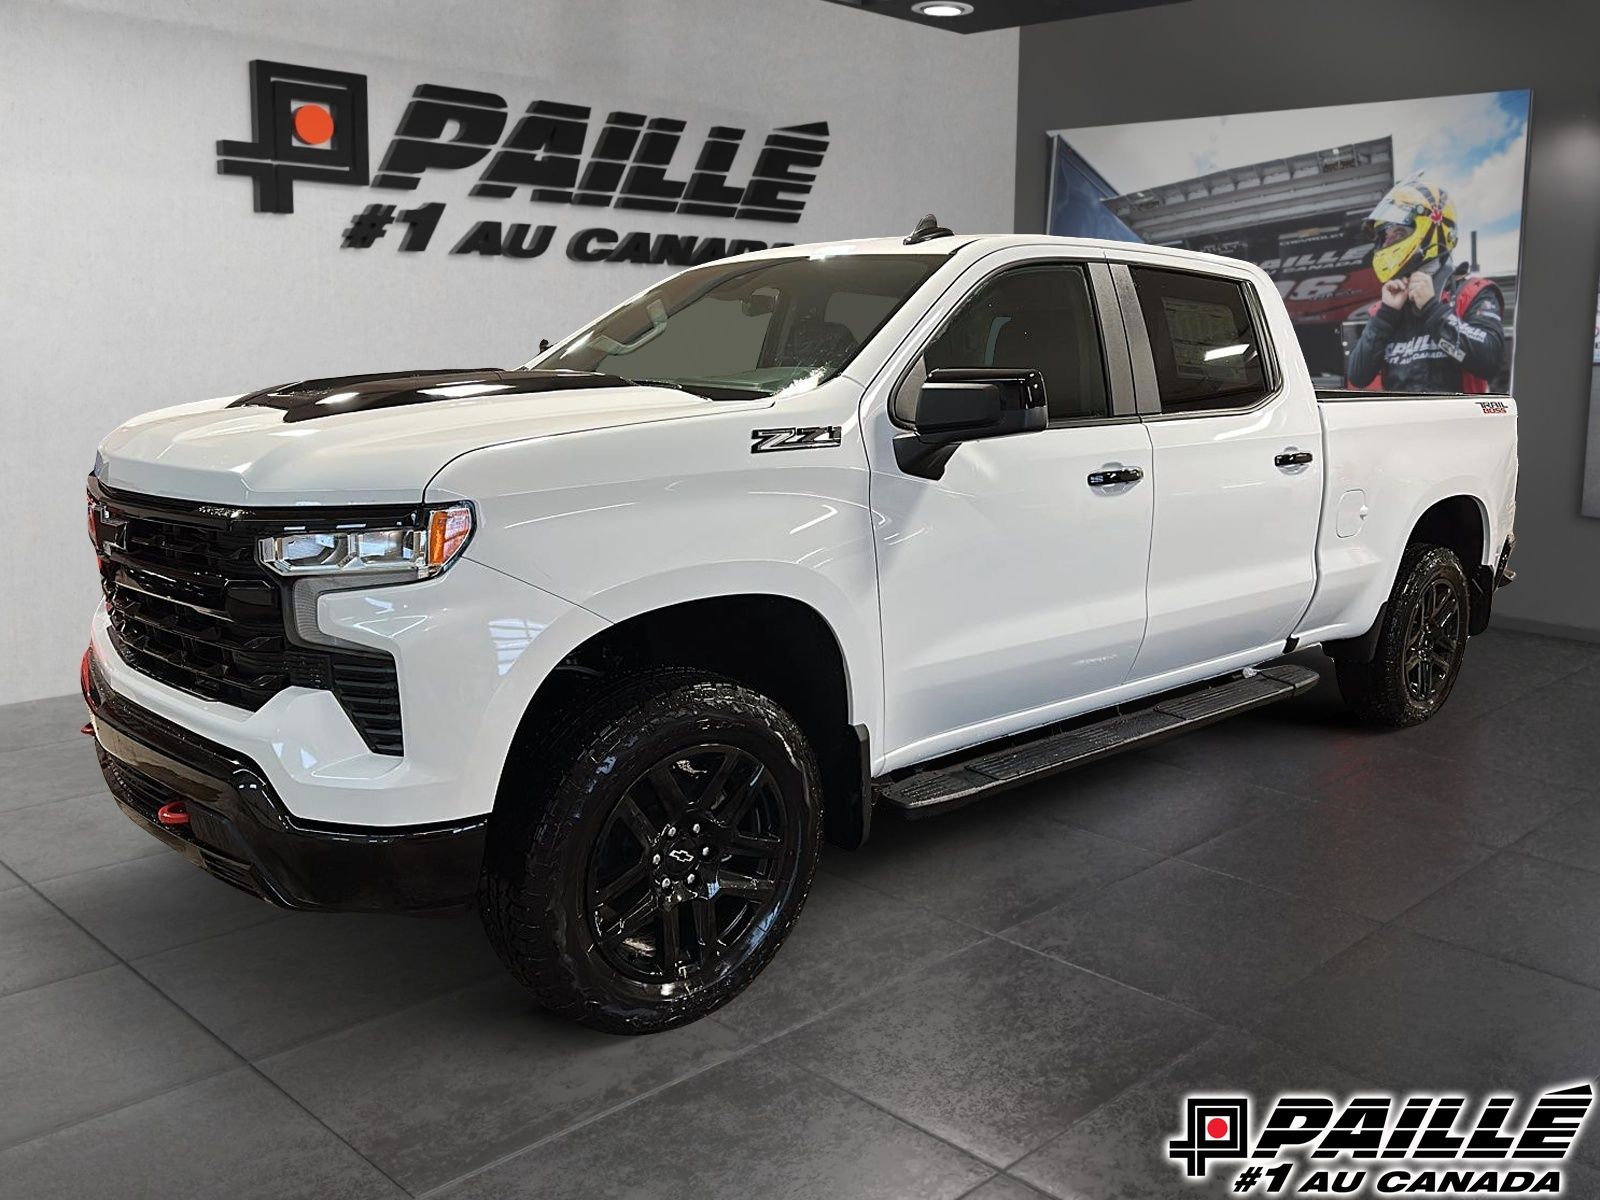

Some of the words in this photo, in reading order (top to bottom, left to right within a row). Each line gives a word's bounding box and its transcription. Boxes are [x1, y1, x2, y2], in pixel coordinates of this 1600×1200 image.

[370, 83, 830, 223] PAILLÉ
[341, 202, 446, 252] #1
[448, 220, 557, 259] AU
[566, 227, 796, 266] CANA
[1474, 401, 1509, 409] TRAIL
[750, 426, 842, 454] Z71
